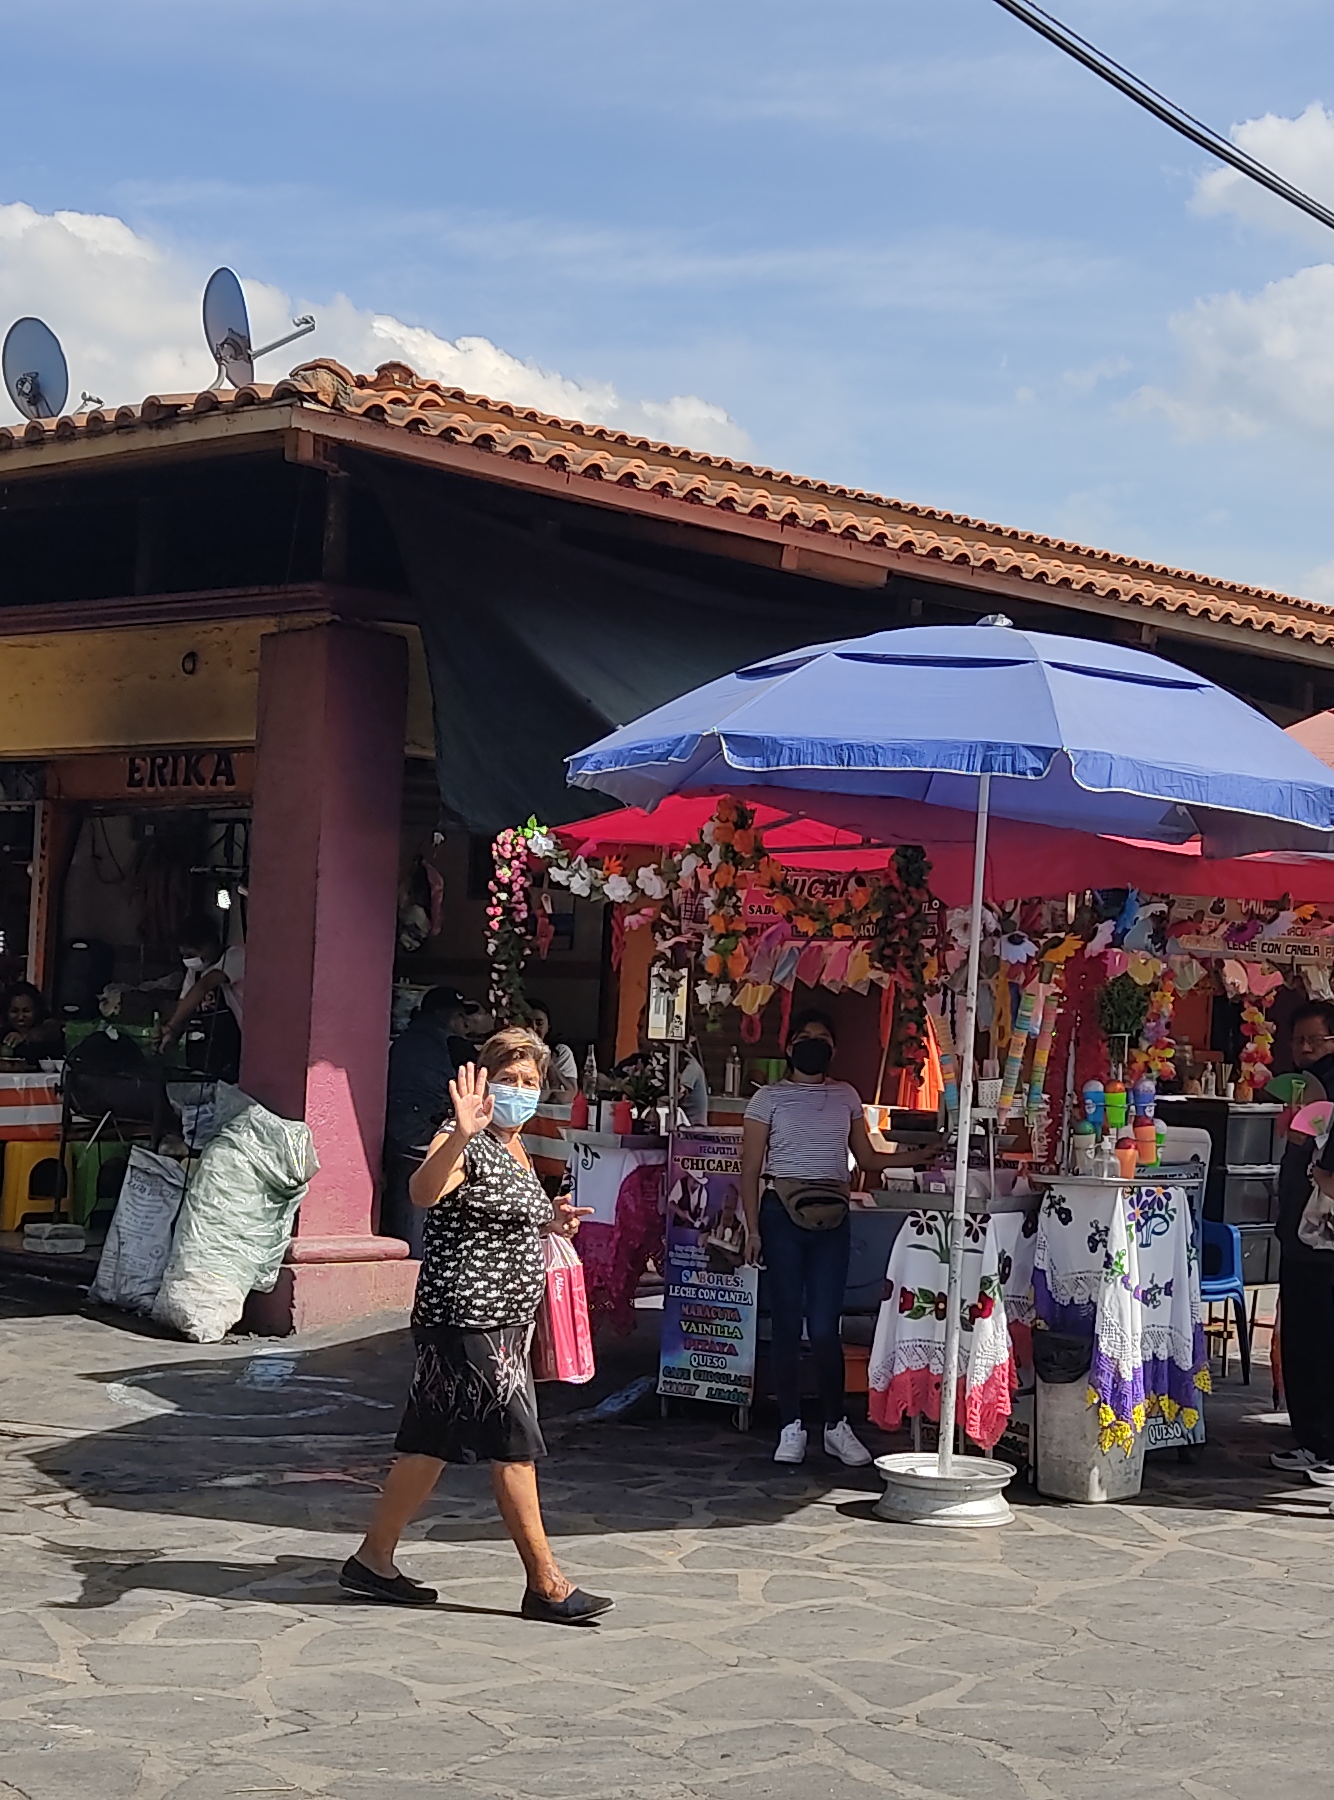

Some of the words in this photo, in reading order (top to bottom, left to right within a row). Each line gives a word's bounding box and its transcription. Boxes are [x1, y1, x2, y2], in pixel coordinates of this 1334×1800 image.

[1227, 940, 1257, 952] LECHE
[1261, 943, 1282, 954] CON
[1285, 944, 1320, 957] CANELA
[681, 1269, 744, 1288] SABORES:
[669, 1285, 697, 1298] LECHE
[698, 1287, 717, 1301] CON
[717, 1289, 753, 1305] CANELA
[680, 1320, 743, 1340] VAINILLA
[690, 1354, 727, 1369] QUESO
[693, 1369, 752, 1388] CHOCOLATE
[1148, 1422, 1182, 1445] QUESO
